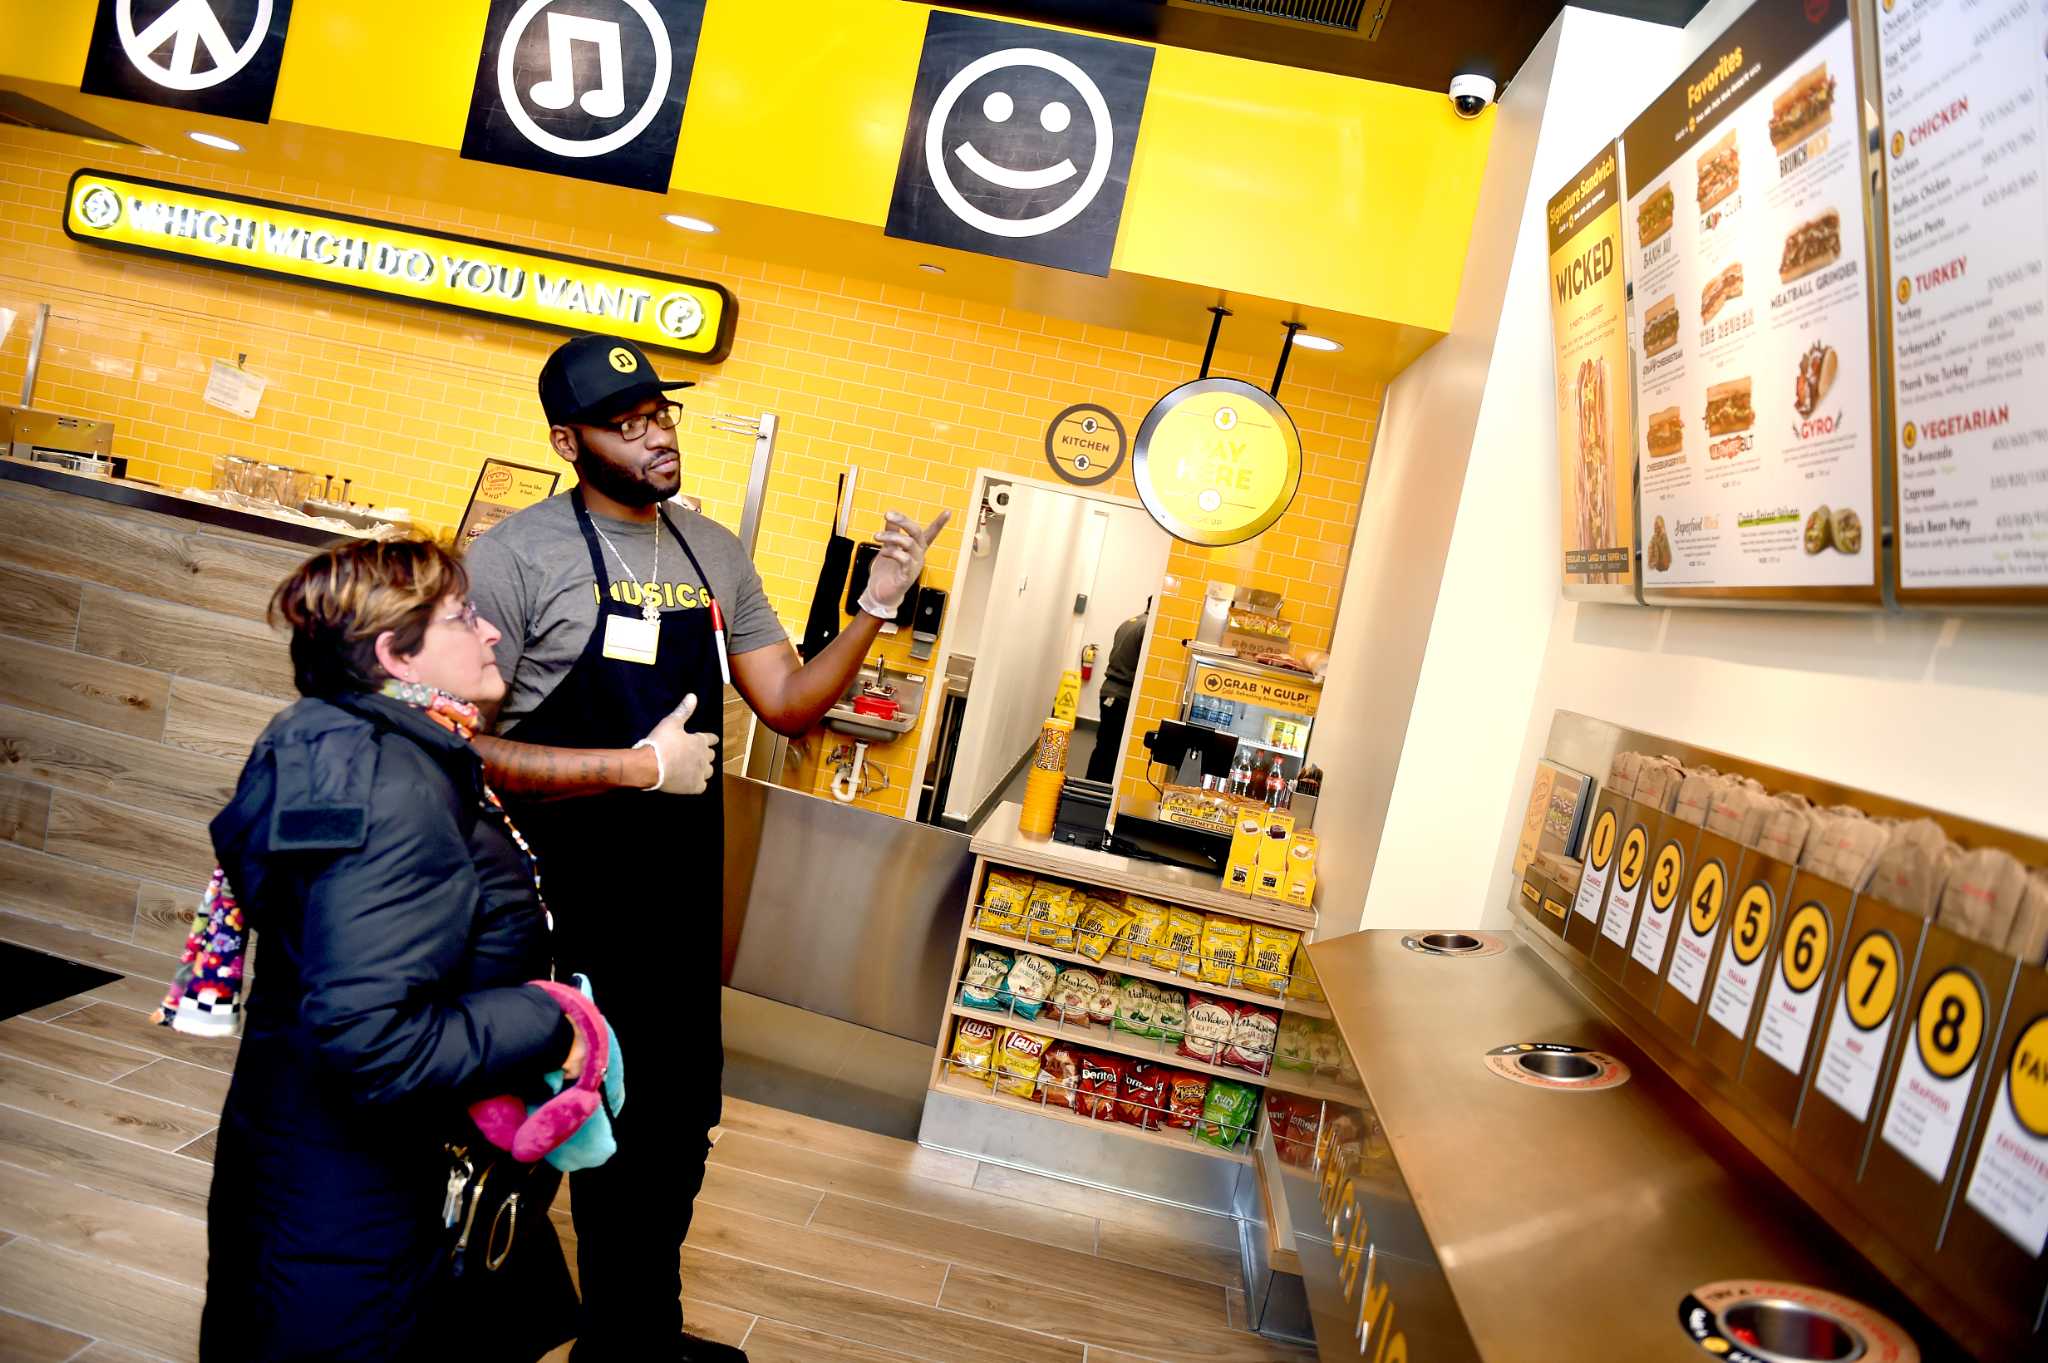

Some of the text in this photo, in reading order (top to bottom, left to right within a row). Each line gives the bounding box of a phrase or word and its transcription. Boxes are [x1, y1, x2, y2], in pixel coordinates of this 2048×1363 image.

[1688, 45, 1743, 110] Favorites
[1908, 96, 1969, 147] CHICKEN
[1549, 188, 1580, 225] Signature
[1581, 154, 1616, 199] Sandwich
[126, 195, 257, 251] WHICH
[263, 220, 370, 271] WICH
[375, 245, 434, 282] DO
[442, 254, 527, 299] YOU
[534, 270, 651, 324] WANT
[1556, 236, 1614, 306] WICKED
[1915, 255, 1967, 294] TURKEY
[1801, 415, 1833, 440] GYRO
[1920, 404, 2010, 440] VEGETARIAN
[1061, 433, 1110, 453] KITCHEN
[1223, 678, 1309, 703] GRAB 'N GULP!
[1598, 824, 1609, 857] 1
[1623, 839, 1641, 878] 2
[1657, 858, 1674, 897] 3
[991, 897, 1013, 910] HOUSE
[1031, 899, 1051, 912] HOUSE
[1696, 879, 1716, 920] 4
[1173, 932, 1195, 946] HOUSE
[1740, 901, 1763, 949] 5
[1169, 941, 1193, 955] CHIPS
[1214, 948, 1237, 960] HOUSE
[1258, 950, 1281, 963] HOUSE
[1793, 924, 1818, 974] 6
[1255, 960, 1280, 973] CHIPS
[1859, 955, 1886, 1008] 7
[1931, 994, 1967, 1056] 8
[1007, 1032, 1043, 1055] Lay's
[1082, 1069, 1117, 1083] Doritos
